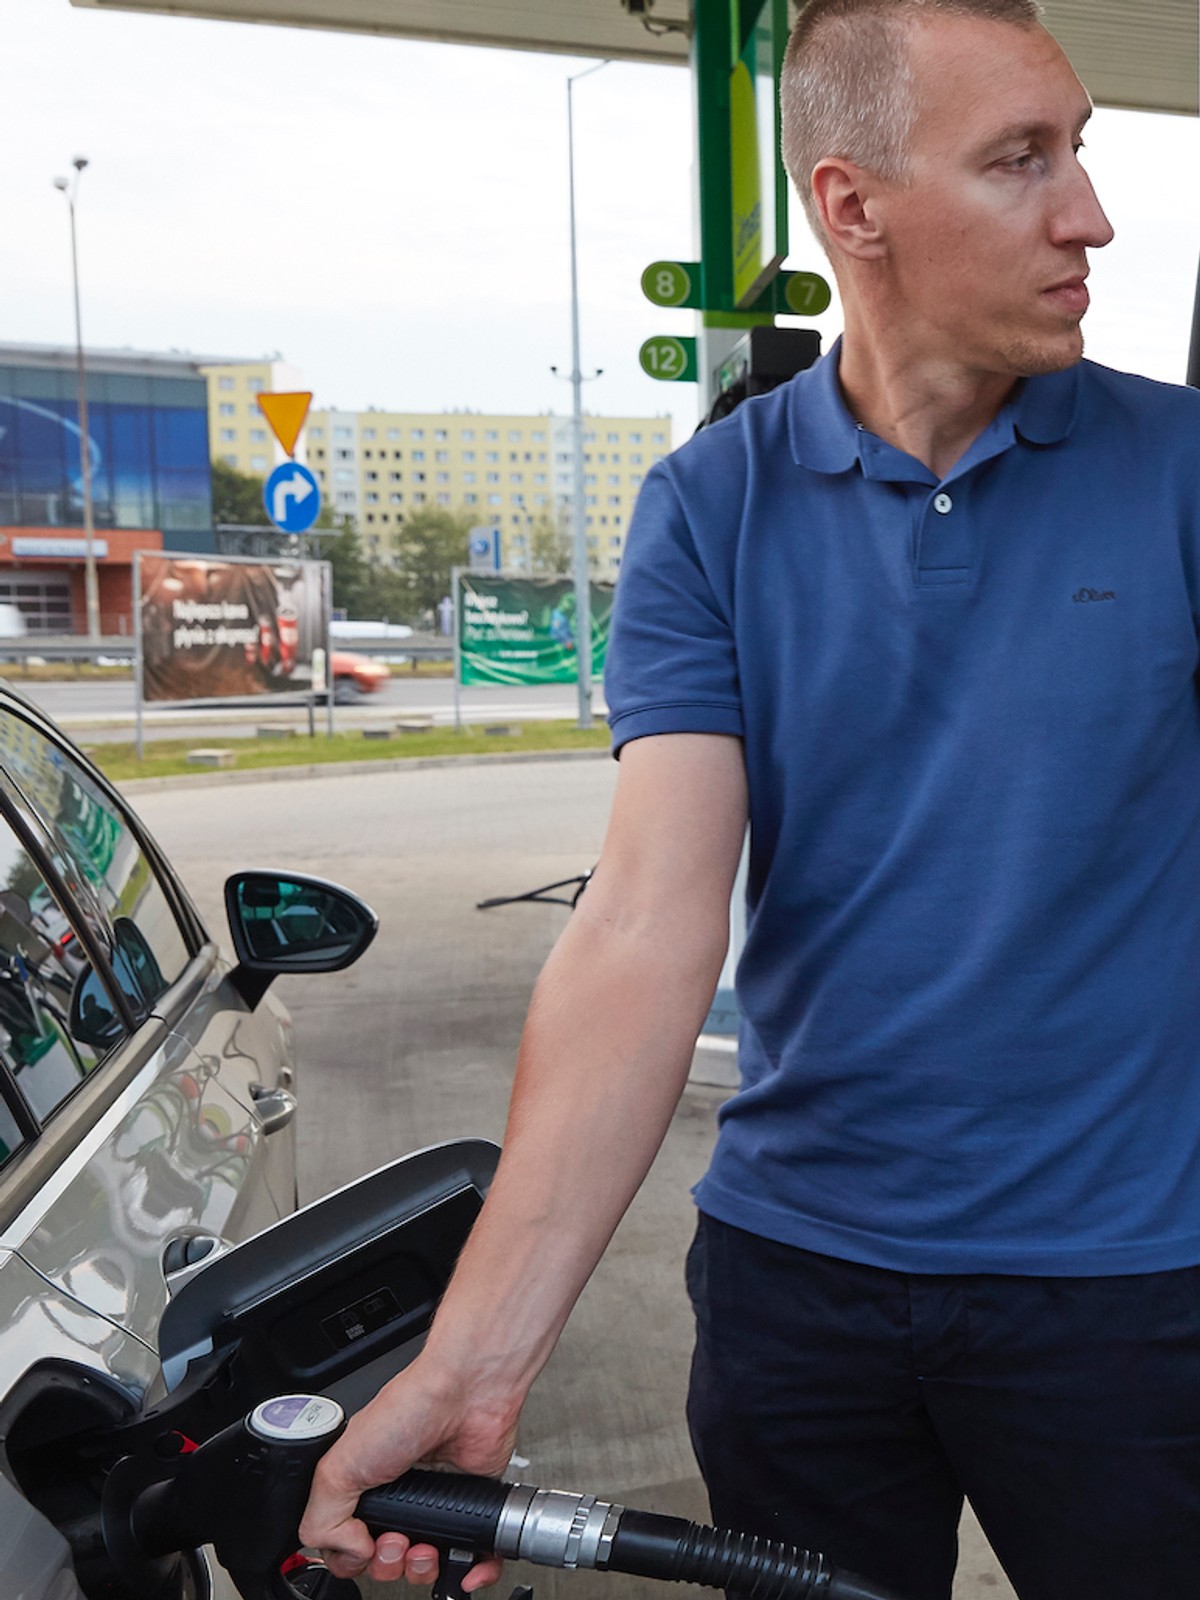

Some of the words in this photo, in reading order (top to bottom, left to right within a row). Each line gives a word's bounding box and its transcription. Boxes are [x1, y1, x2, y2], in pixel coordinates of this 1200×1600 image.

[656, 271, 675, 297] 8
[801, 281, 817, 305] 7
[647, 345, 677, 372] 12
